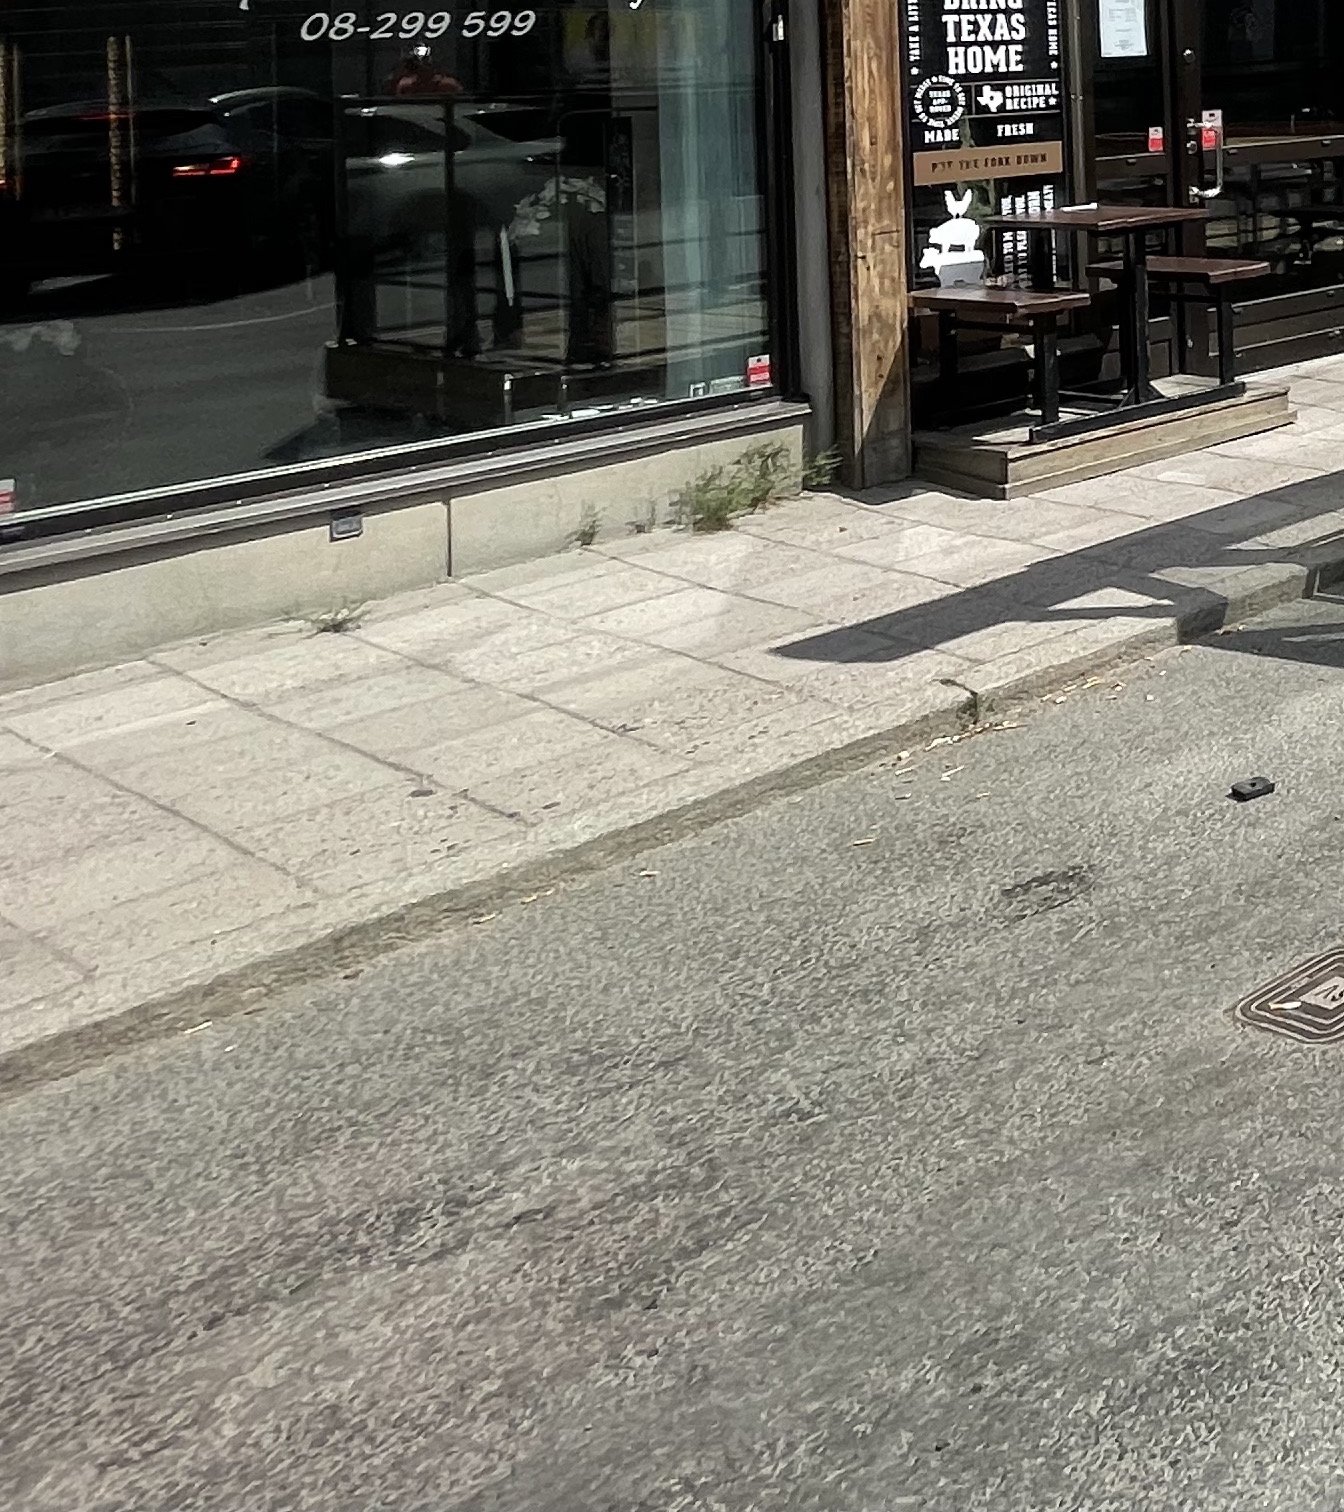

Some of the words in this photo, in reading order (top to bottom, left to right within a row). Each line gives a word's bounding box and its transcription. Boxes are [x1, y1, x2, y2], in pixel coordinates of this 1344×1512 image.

[300, 12, 451, 42] 08-299
[461, 9, 537, 37] 599
[941, 13, 1026, 42] TEXAS
[947, 44, 1024, 75] HOME
[1005, 83, 1060, 97] ORIGINAL
[1005, 96, 1046, 110] RECIPE
[924, 129, 960, 144] MADE
[997, 122, 1034, 137] FRESH
